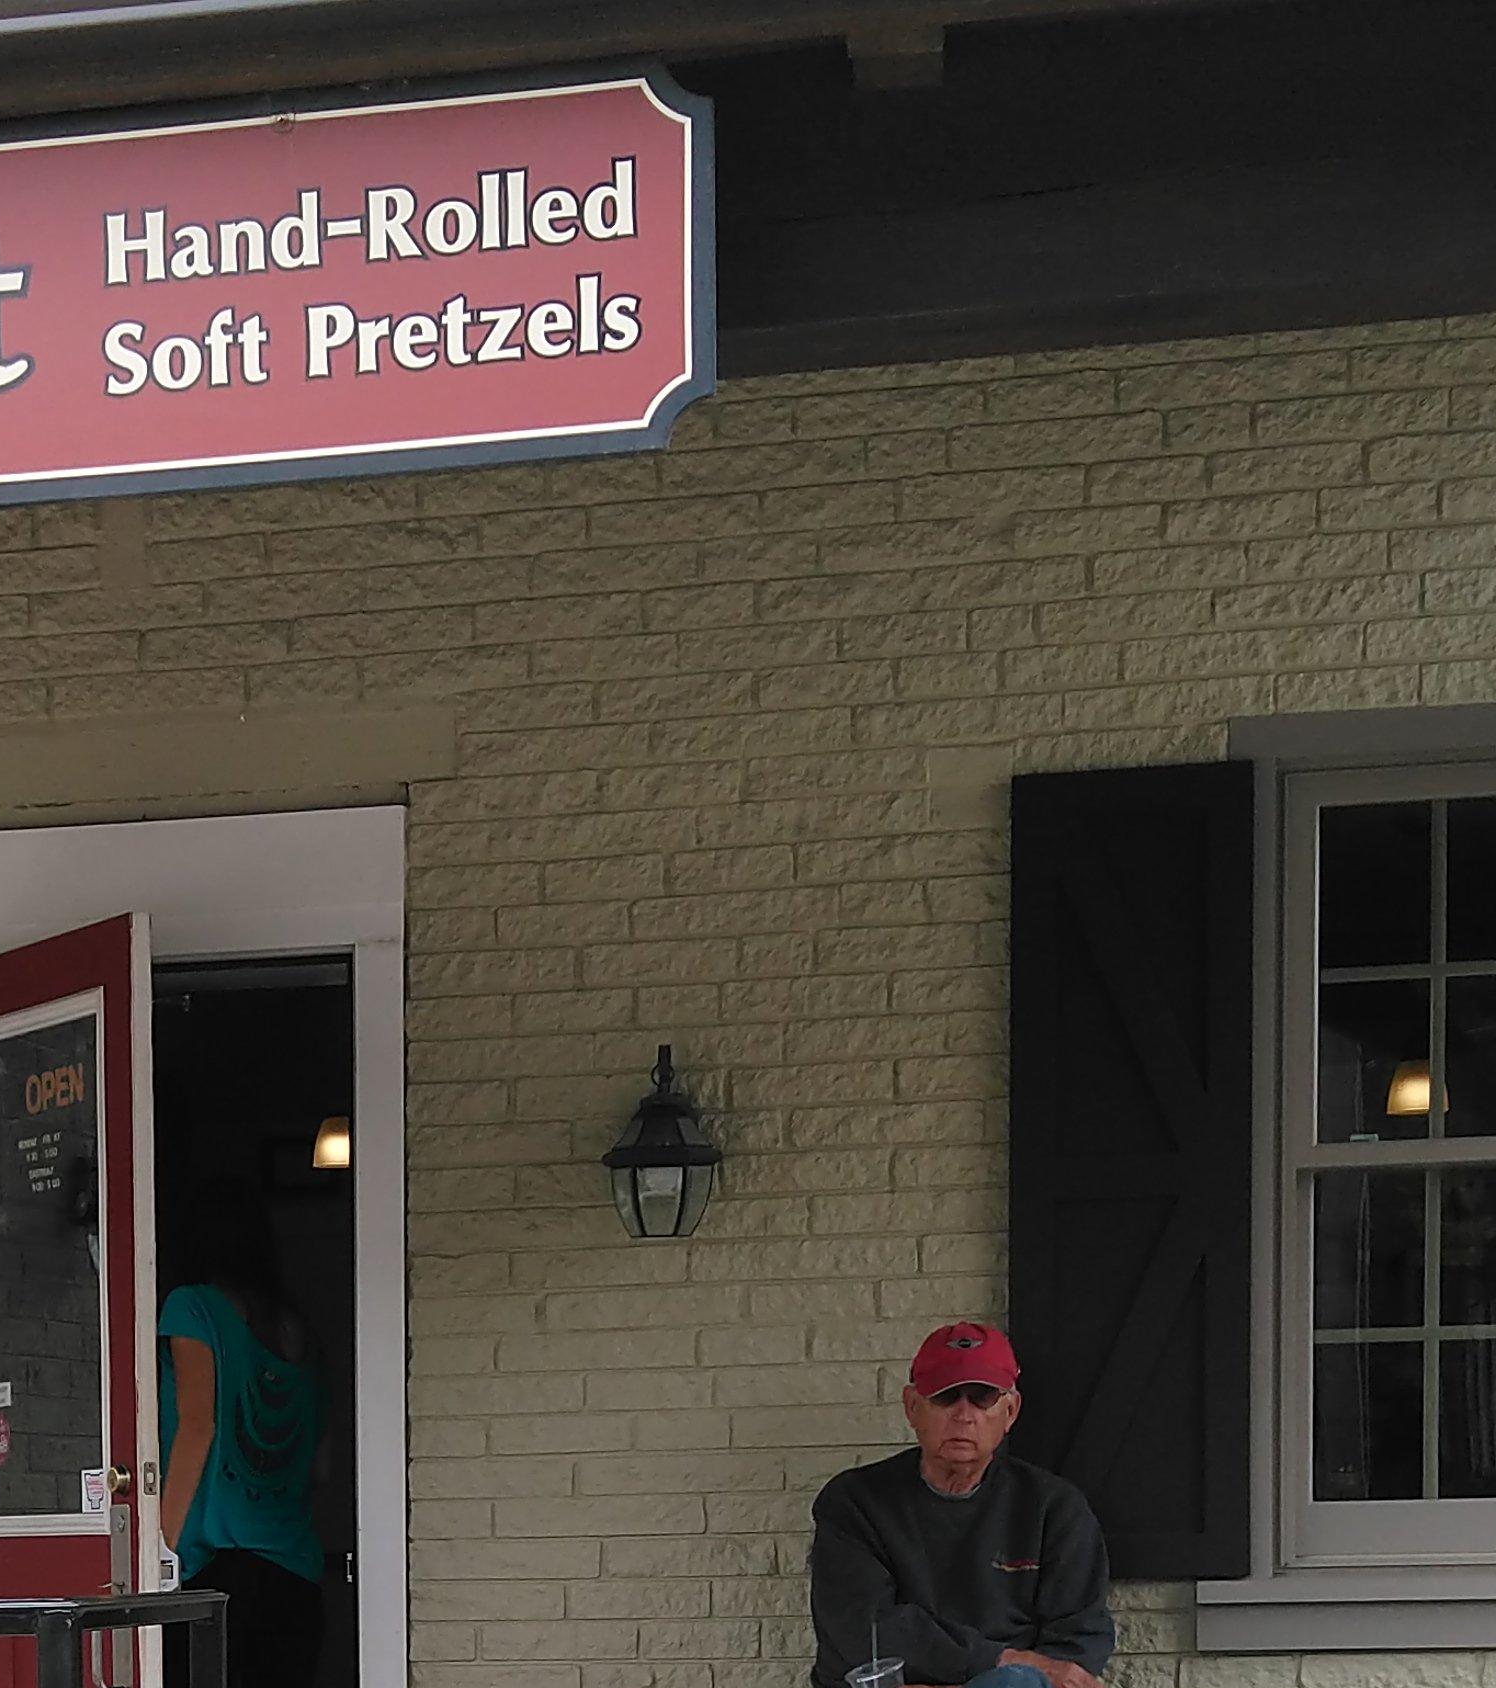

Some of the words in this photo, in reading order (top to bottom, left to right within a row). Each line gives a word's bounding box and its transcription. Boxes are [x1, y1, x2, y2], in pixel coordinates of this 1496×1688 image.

[104, 156, 637, 285] Hand-Rolled
[104, 306, 269, 396] Soft
[304, 273, 641, 379] Pretzels
[25, 1062, 85, 1115] OPEN
